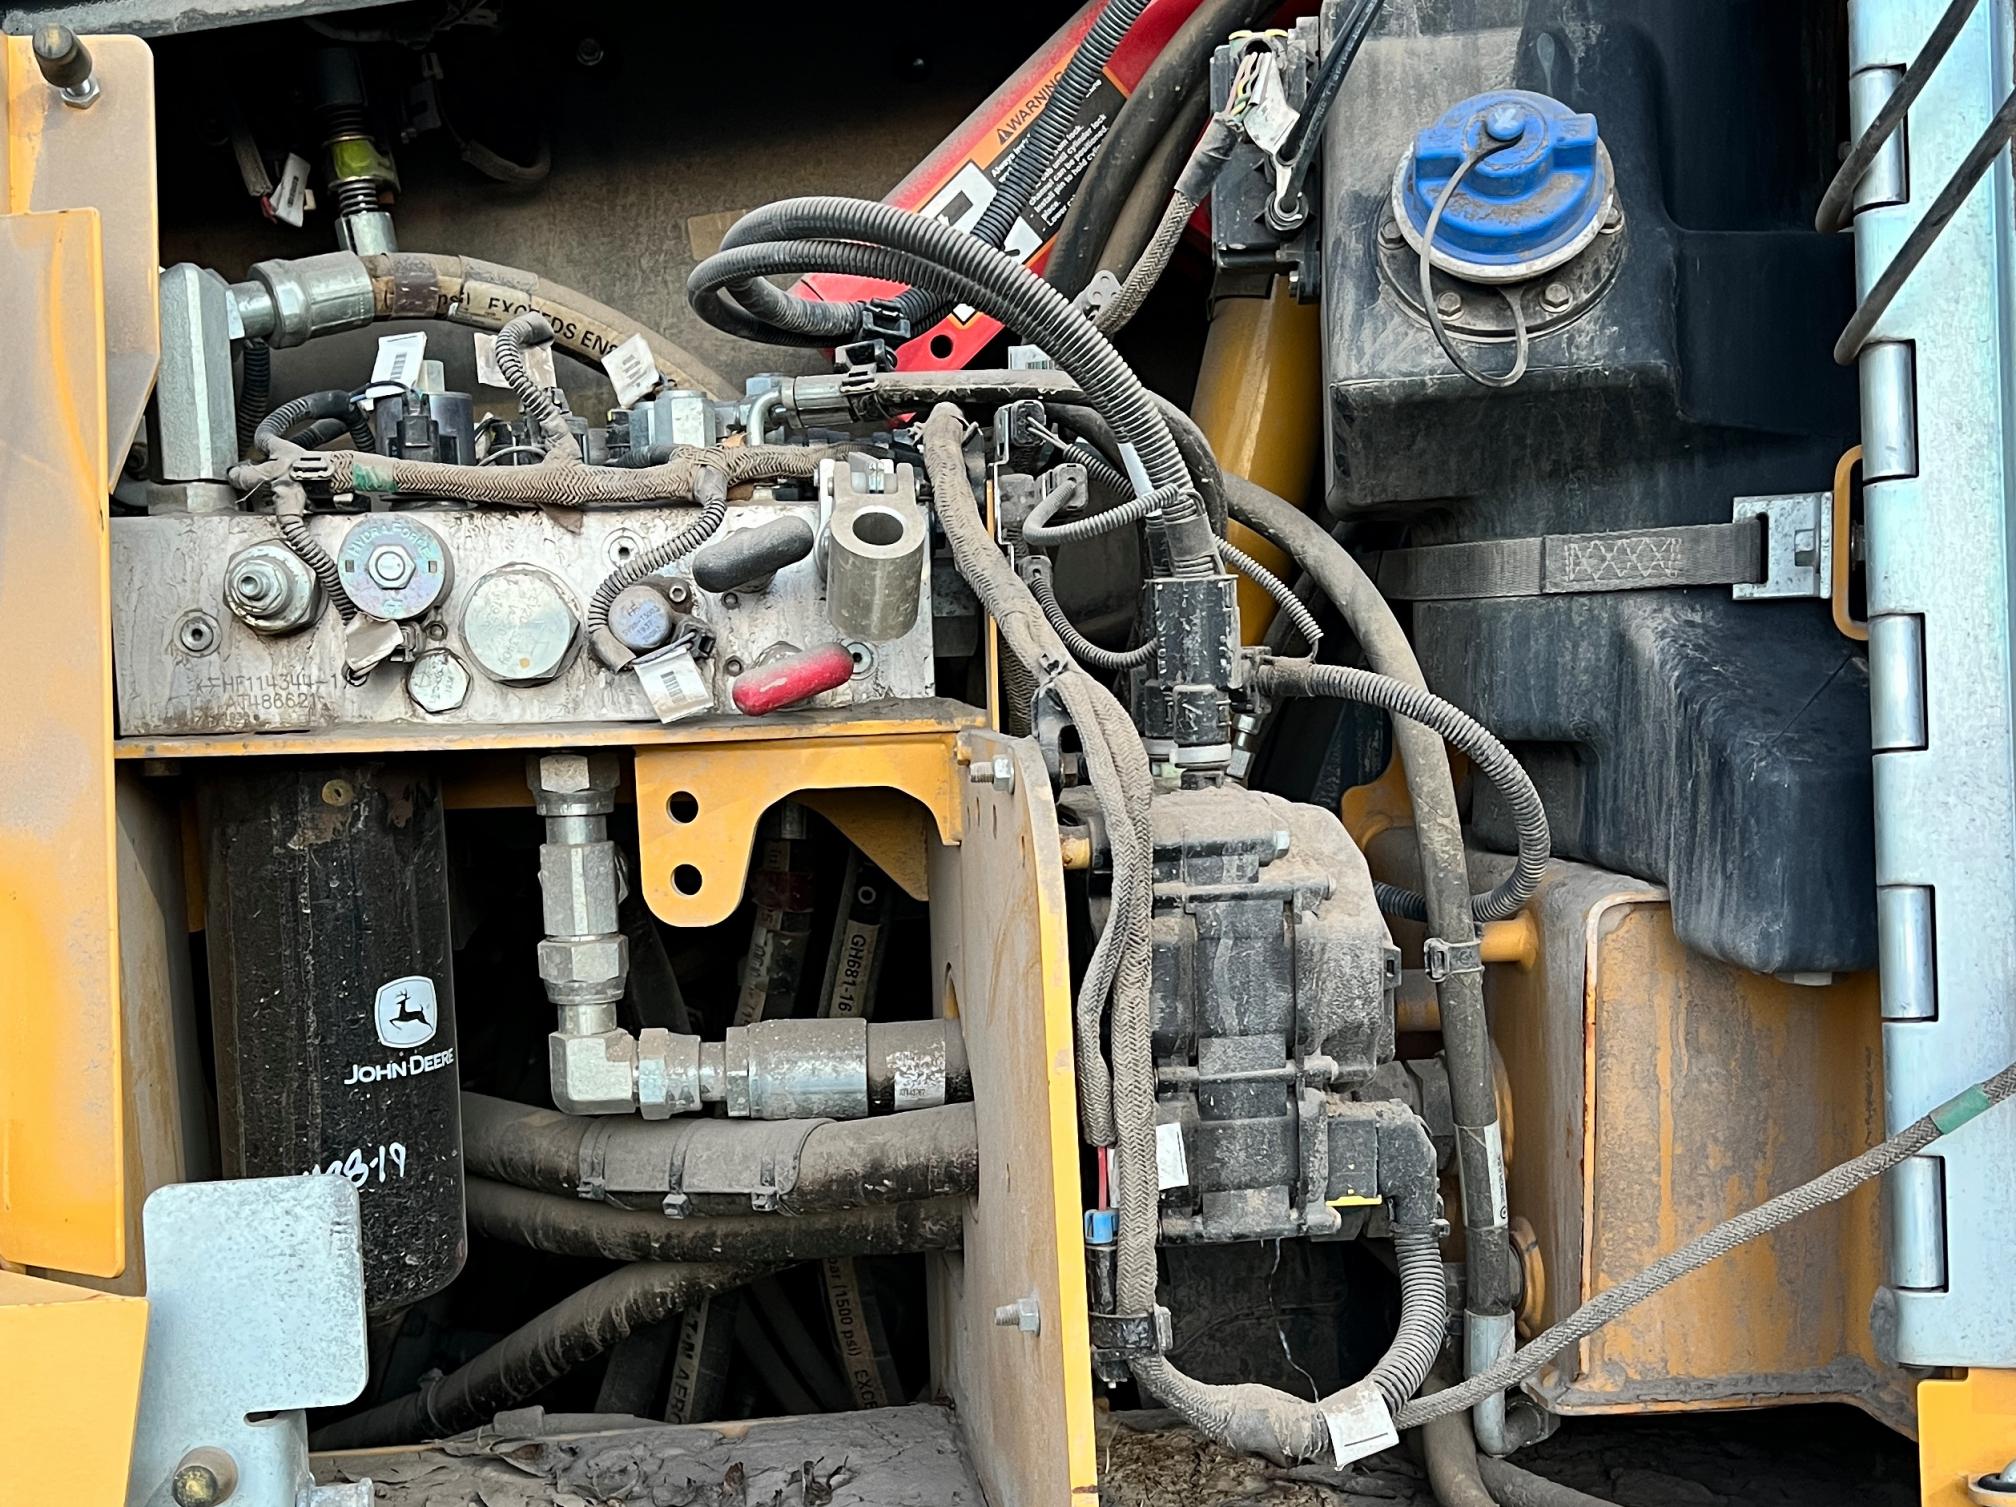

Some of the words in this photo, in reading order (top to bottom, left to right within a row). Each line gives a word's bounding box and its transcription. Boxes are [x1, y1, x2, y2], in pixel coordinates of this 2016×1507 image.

[1051, 152, 1068, 168] until
[1066, 127, 1093, 155] cylinder
[1090, 113, 1106, 129] lock
[1028, 179, 1054, 205] channel
[1053, 168, 1066, 181] can
[1064, 158, 1075, 168] be
[1034, 191, 1054, 212] Install
[1053, 181, 1066, 194] pin
[1064, 174, 1073, 182] to
[1071, 159, 1087, 175] hold
[1046, 204, 1067, 225] Lower
[344, 1062, 407, 1085] JOHN
[410, 1048, 455, 1076] DEERE
